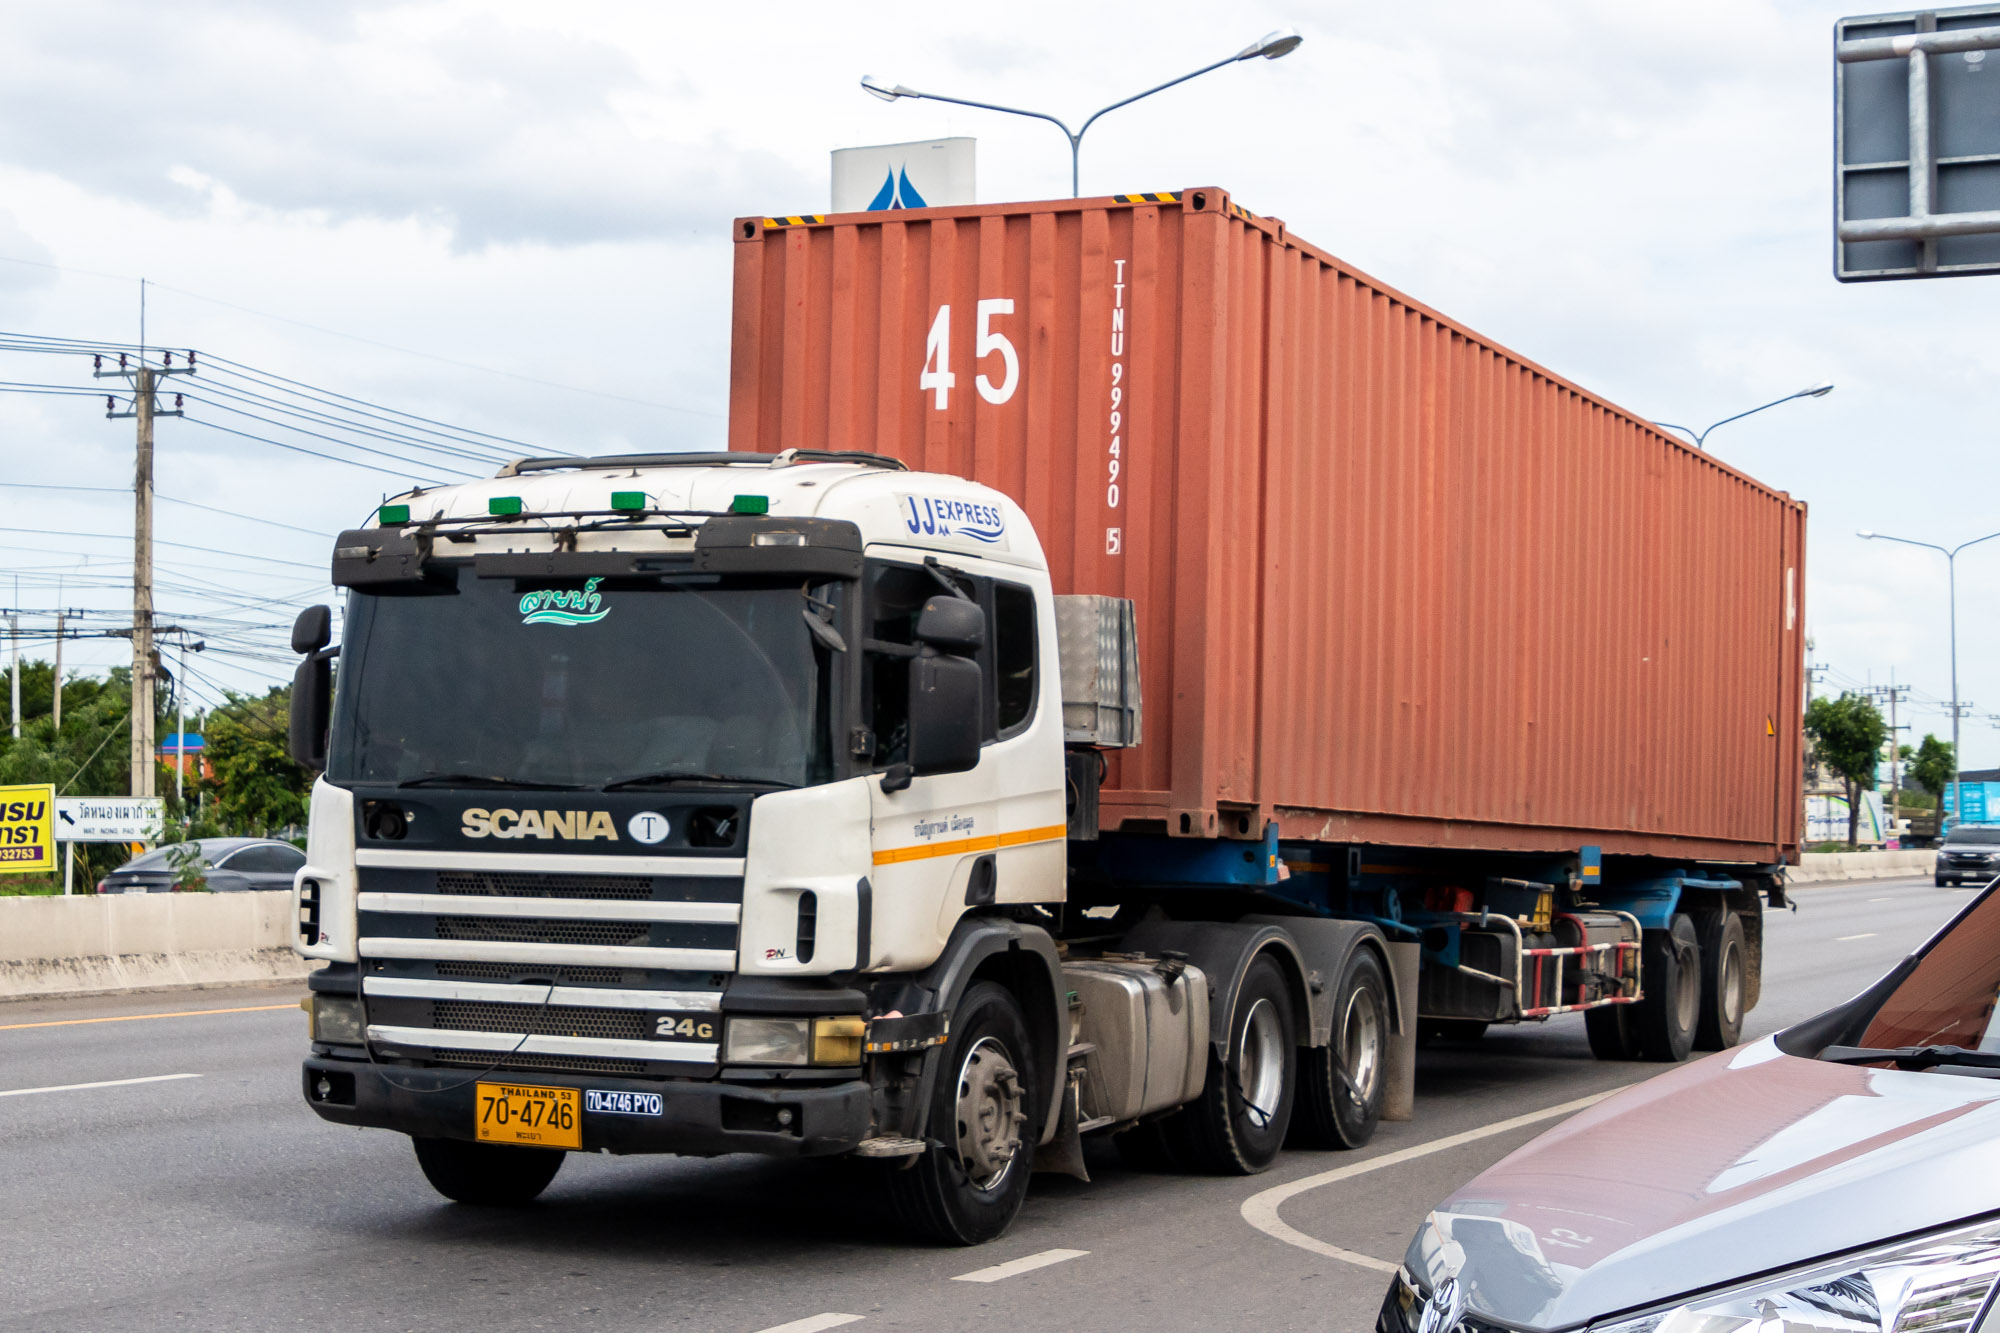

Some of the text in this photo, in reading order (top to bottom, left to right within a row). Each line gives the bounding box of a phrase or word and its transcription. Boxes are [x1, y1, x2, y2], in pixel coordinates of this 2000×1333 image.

[920, 298, 1020, 410] 45
[1107, 259, 1126, 554] TTNU 999490 5
[907, 496, 1001, 535] JJ EXPRESS
[461, 808, 619, 841] SCANIA
[641, 816, 657, 840] T
[0, 848, 35, 861] 32753
[500, 1087, 572, 1100] THAILAND 53
[588, 1092, 660, 1113] 70-4746 PYO
[482, 1096, 573, 1130] 70-4746
